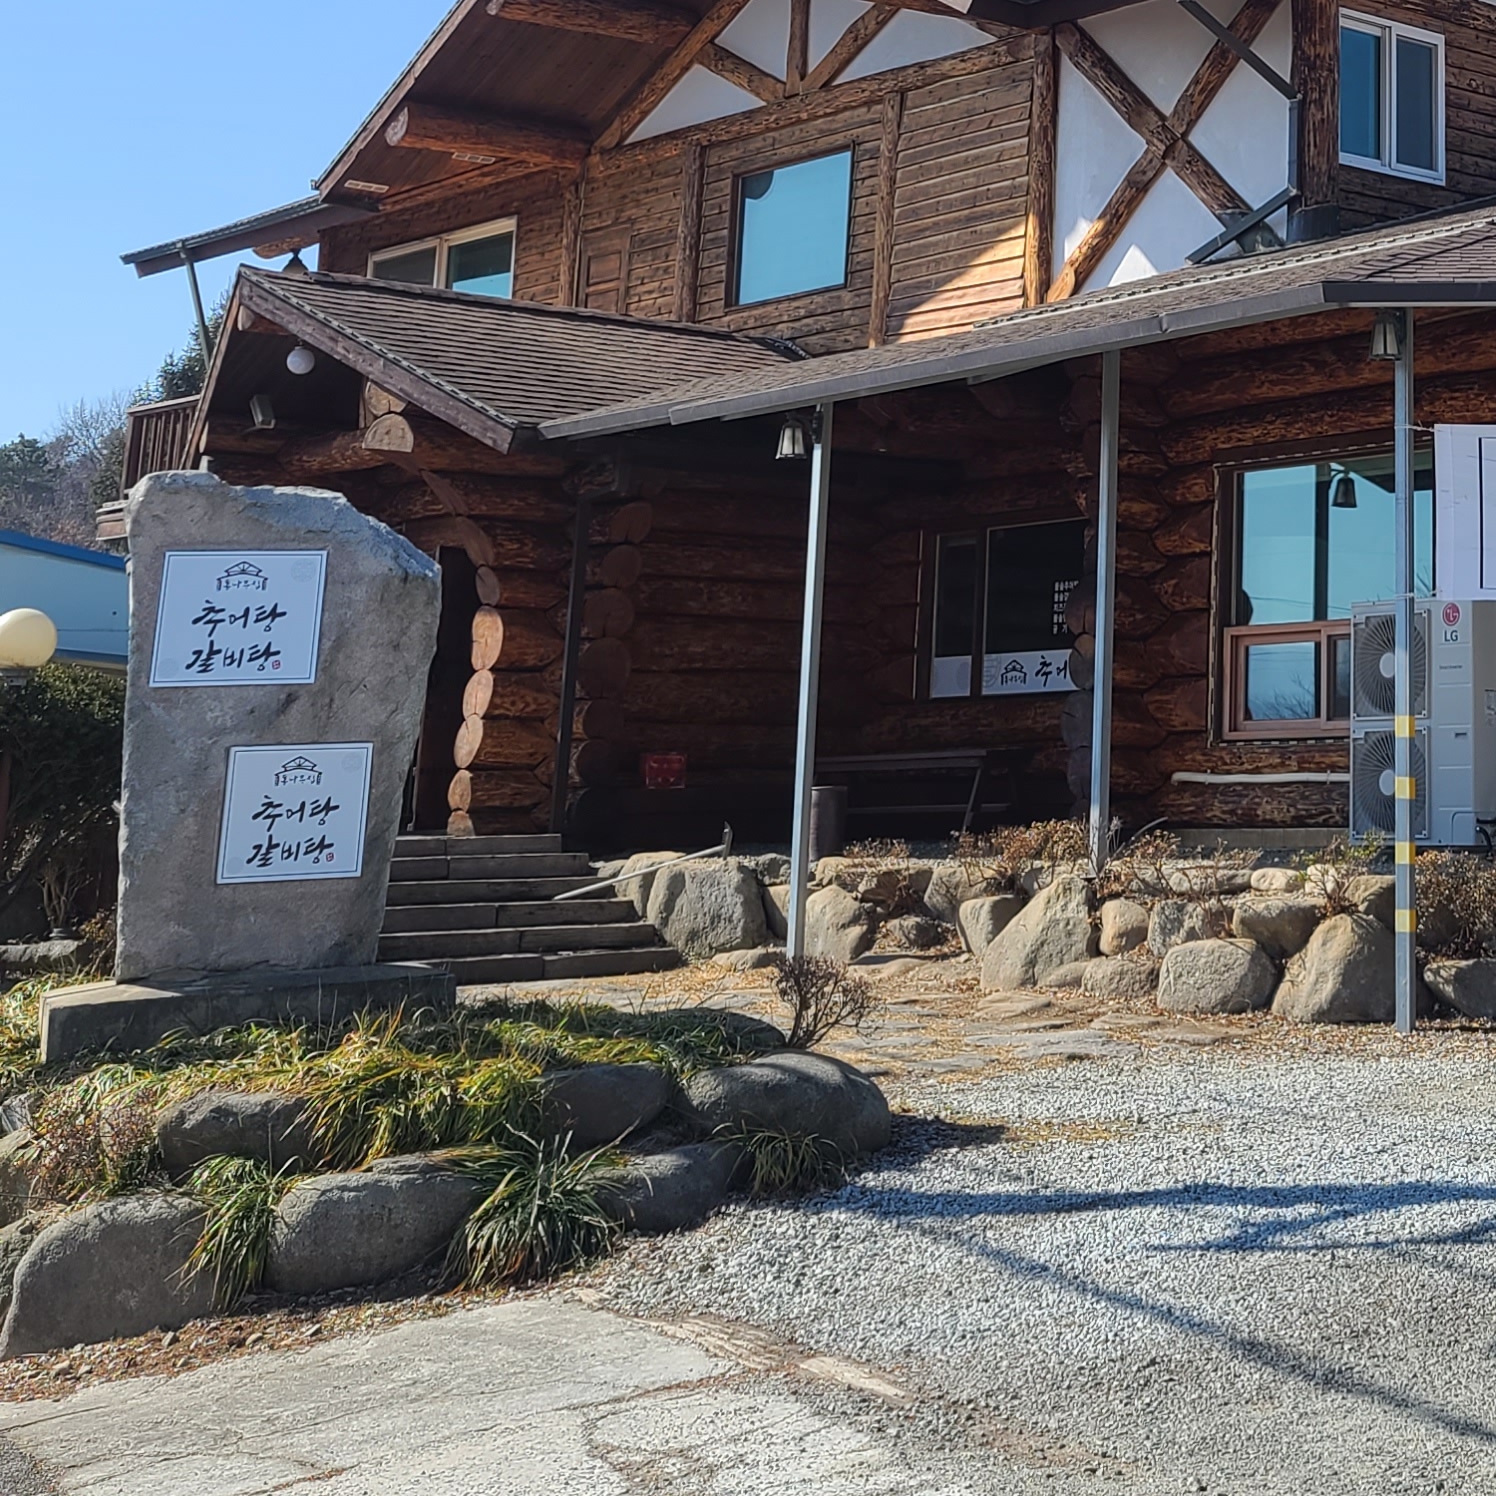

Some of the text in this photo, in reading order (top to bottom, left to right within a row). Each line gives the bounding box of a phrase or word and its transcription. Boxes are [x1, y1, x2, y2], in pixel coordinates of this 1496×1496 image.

[191, 599, 287, 638] 추어탕
[1444, 629, 1459, 642] LG
[184, 639, 281, 674] 갈비탕
[251, 794, 340, 833] 추어탕
[245, 834, 334, 868] 갈비탕
